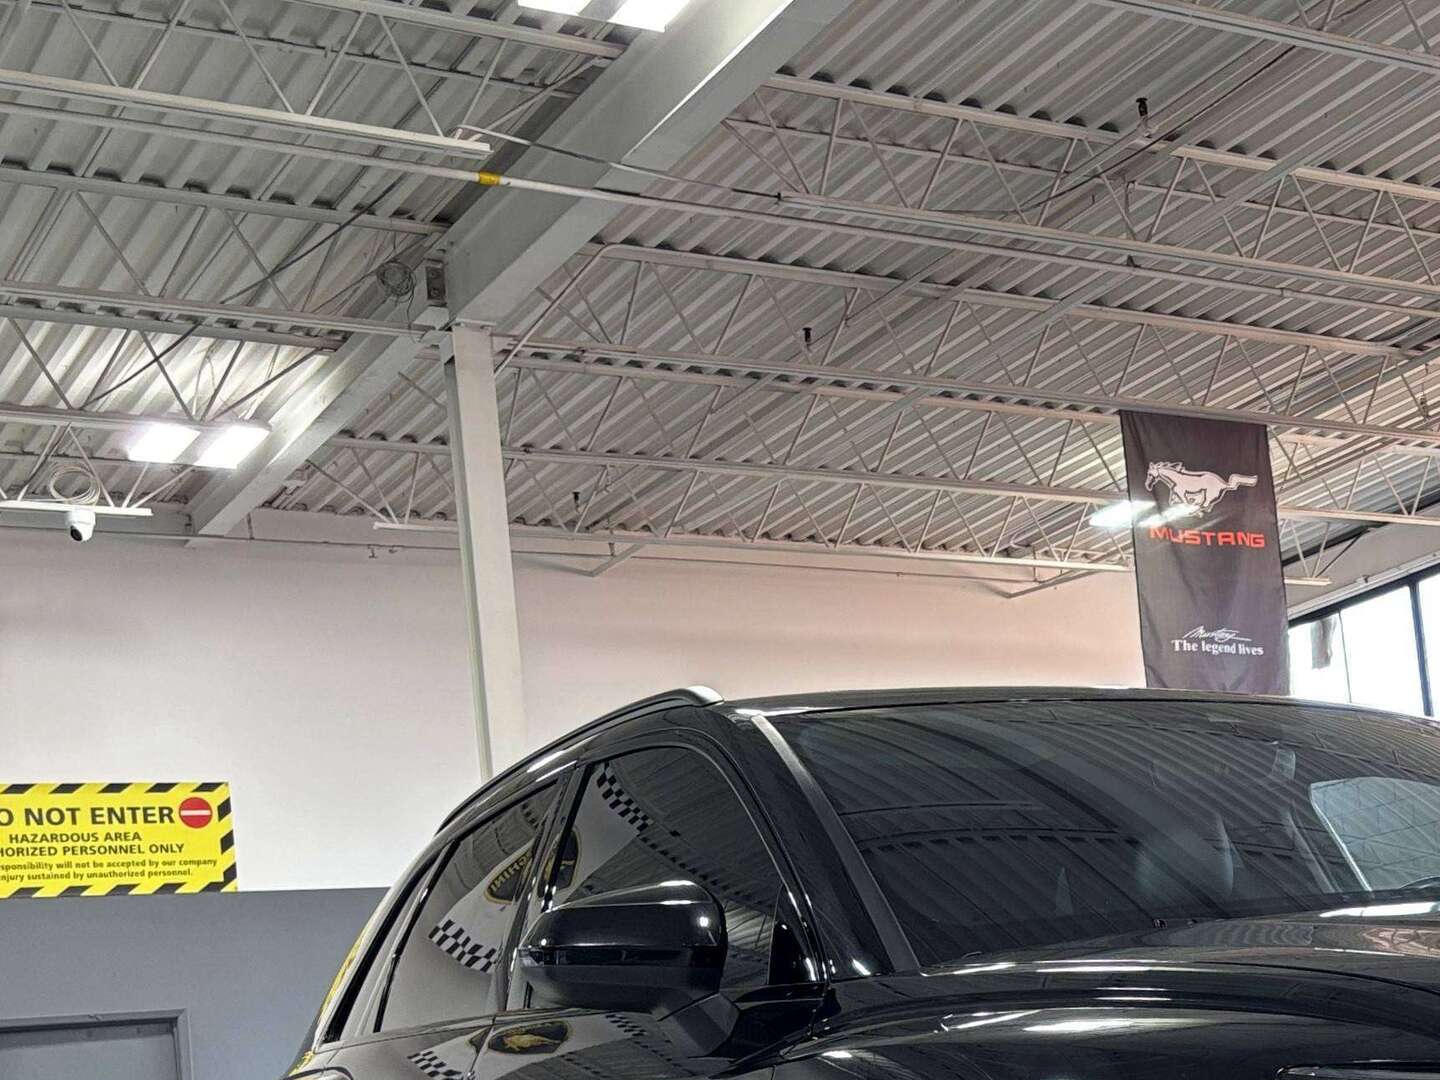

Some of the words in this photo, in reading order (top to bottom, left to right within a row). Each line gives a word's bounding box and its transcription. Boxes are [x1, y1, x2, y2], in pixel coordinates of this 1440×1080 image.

[1149, 525, 1265, 548] MUSTANG
[1171, 639, 1199, 652] The
[1201, 640, 1236, 656] legend
[1238, 643, 1264, 656] lives
[24, 807, 80, 826] NOT
[90, 806, 175, 825] ENTER
[9, 832, 99, 844] HAZARDOUS
[104, 832, 142, 842] AREA
[63, 844, 145, 856] PERSONNEL
[149, 843, 184, 854] ONLY
[55, 861, 73, 869] will
[75, 861, 90, 869] not
[93, 860, 104, 868] be
[107, 859, 146, 868] accepted
[149, 859, 159, 868] by
[179, 859, 217, 867] company
[27, 872, 70, 881] sustained
[73, 871, 84, 880] by
[86, 869, 145, 879] unauthorized
